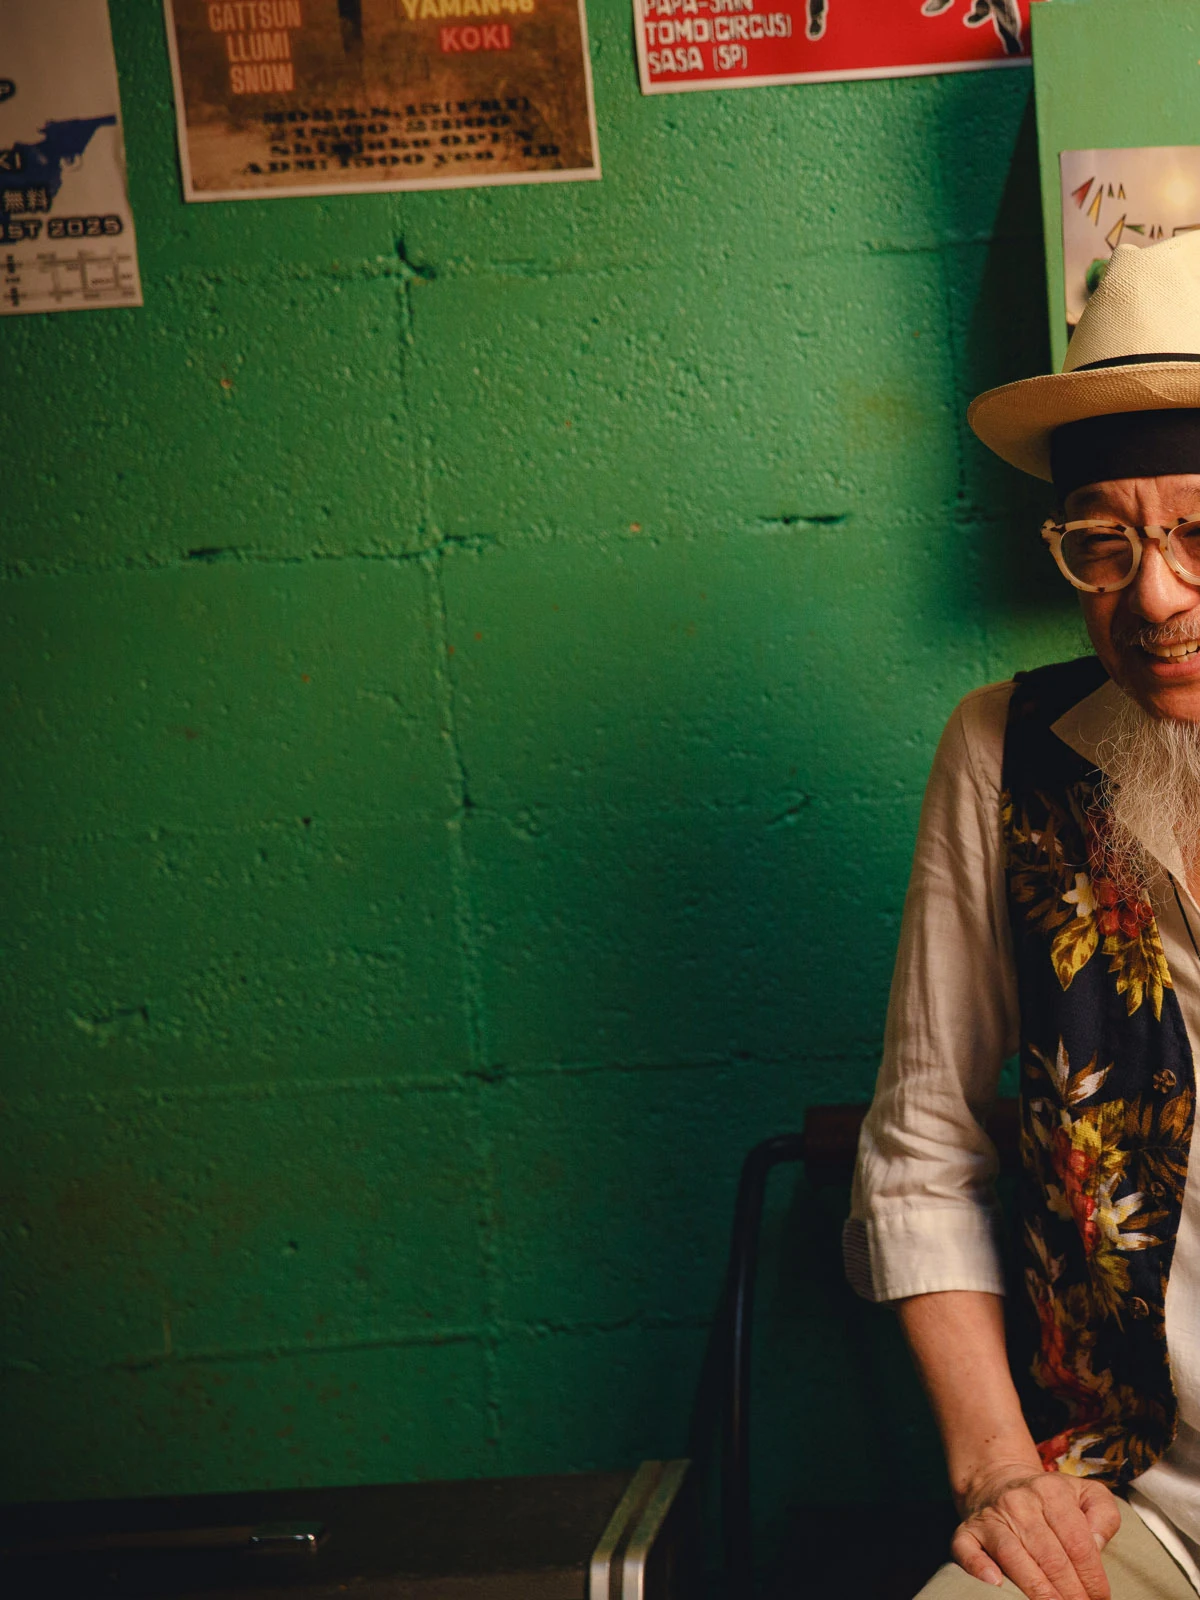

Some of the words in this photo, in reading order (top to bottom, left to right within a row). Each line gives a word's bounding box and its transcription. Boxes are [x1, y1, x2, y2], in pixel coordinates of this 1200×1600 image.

[226, 31, 291, 61] LLUMI
[440, 24, 511, 52] KOKI
[648, 46, 704, 74] SASA
[231, 62, 294, 94] SNOW
